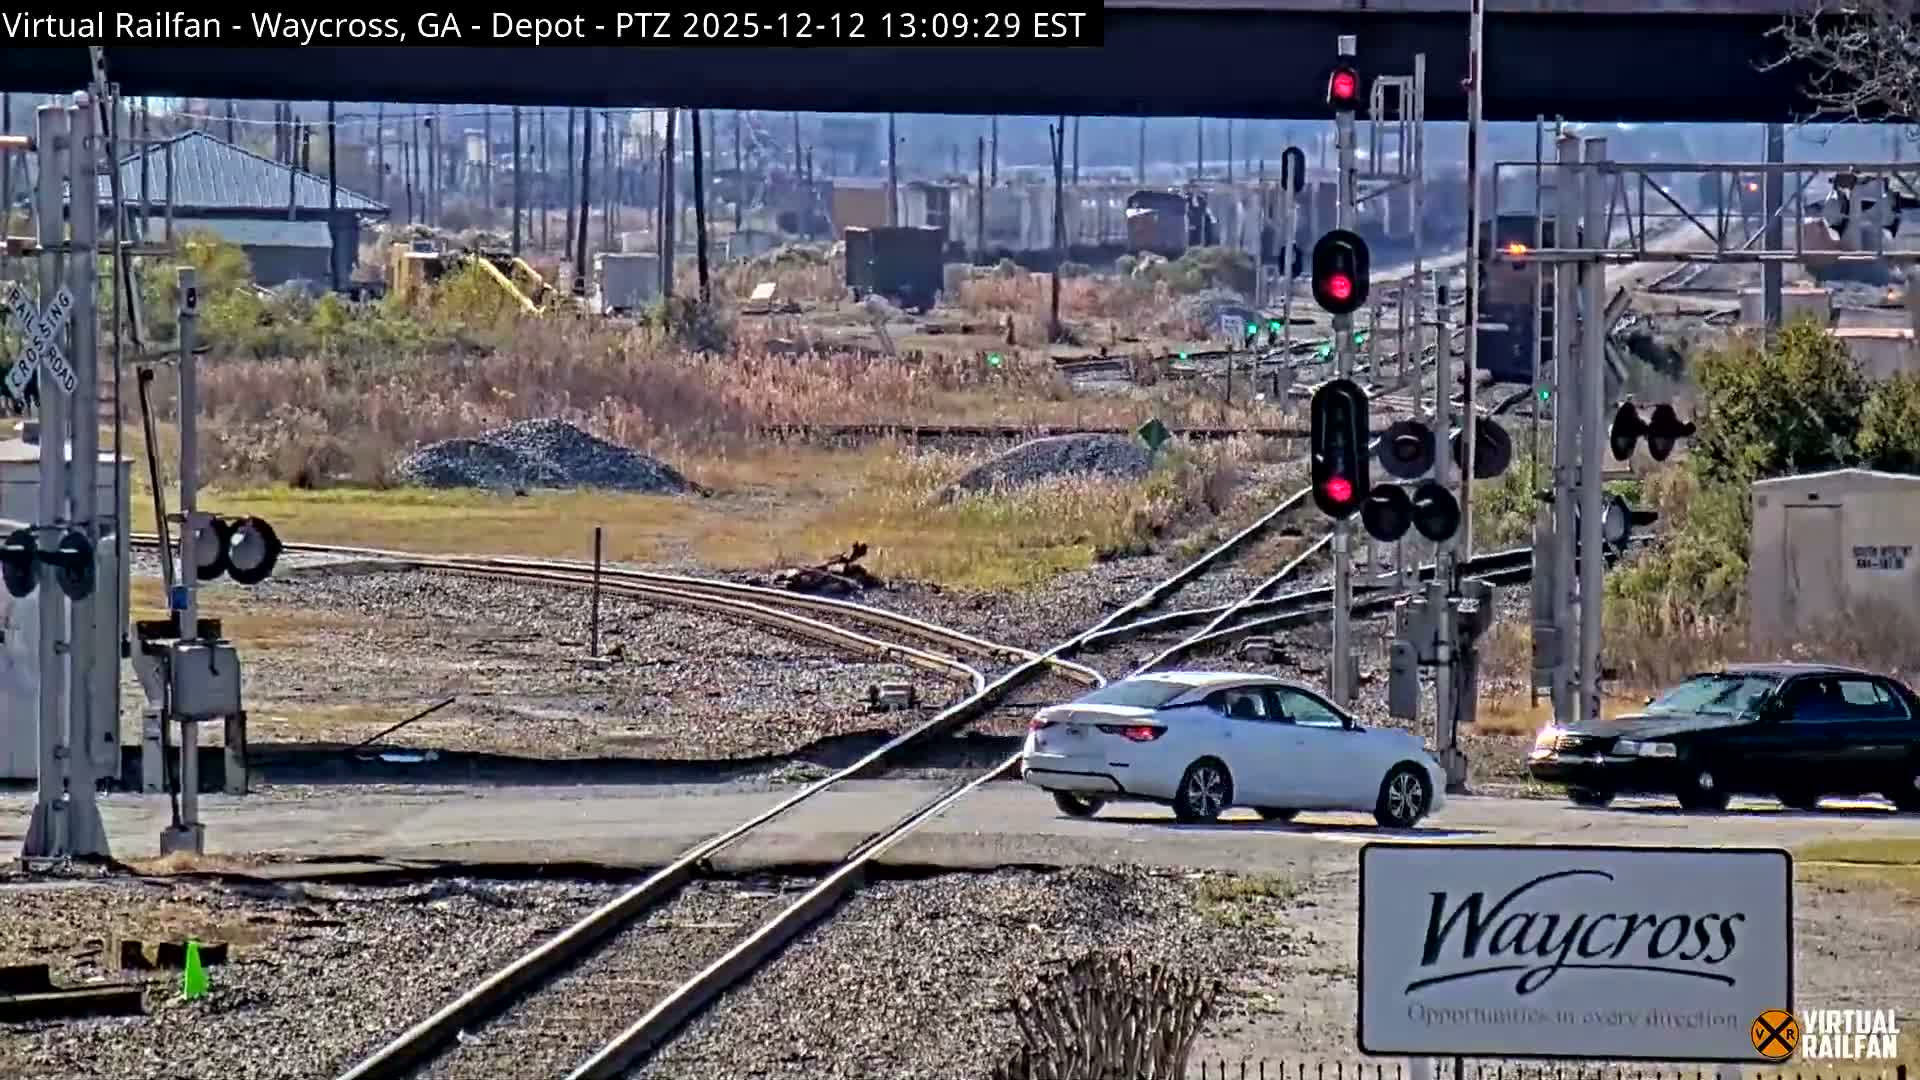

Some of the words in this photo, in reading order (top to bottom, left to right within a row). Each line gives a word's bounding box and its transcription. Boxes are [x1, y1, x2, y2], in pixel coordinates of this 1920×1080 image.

[9, 287, 34, 334] RAIL
[47, 345, 75, 391] ROAD
[11, 291, 70, 388] CROSSING
[1420, 869, 1746, 996] Waycross
[1407, 1002, 1549, 1028] Opportunities
[1556, 1008, 1575, 1025] in
[1582, 1011, 1638, 1030] every
[1645, 1008, 1738, 1031] direction
